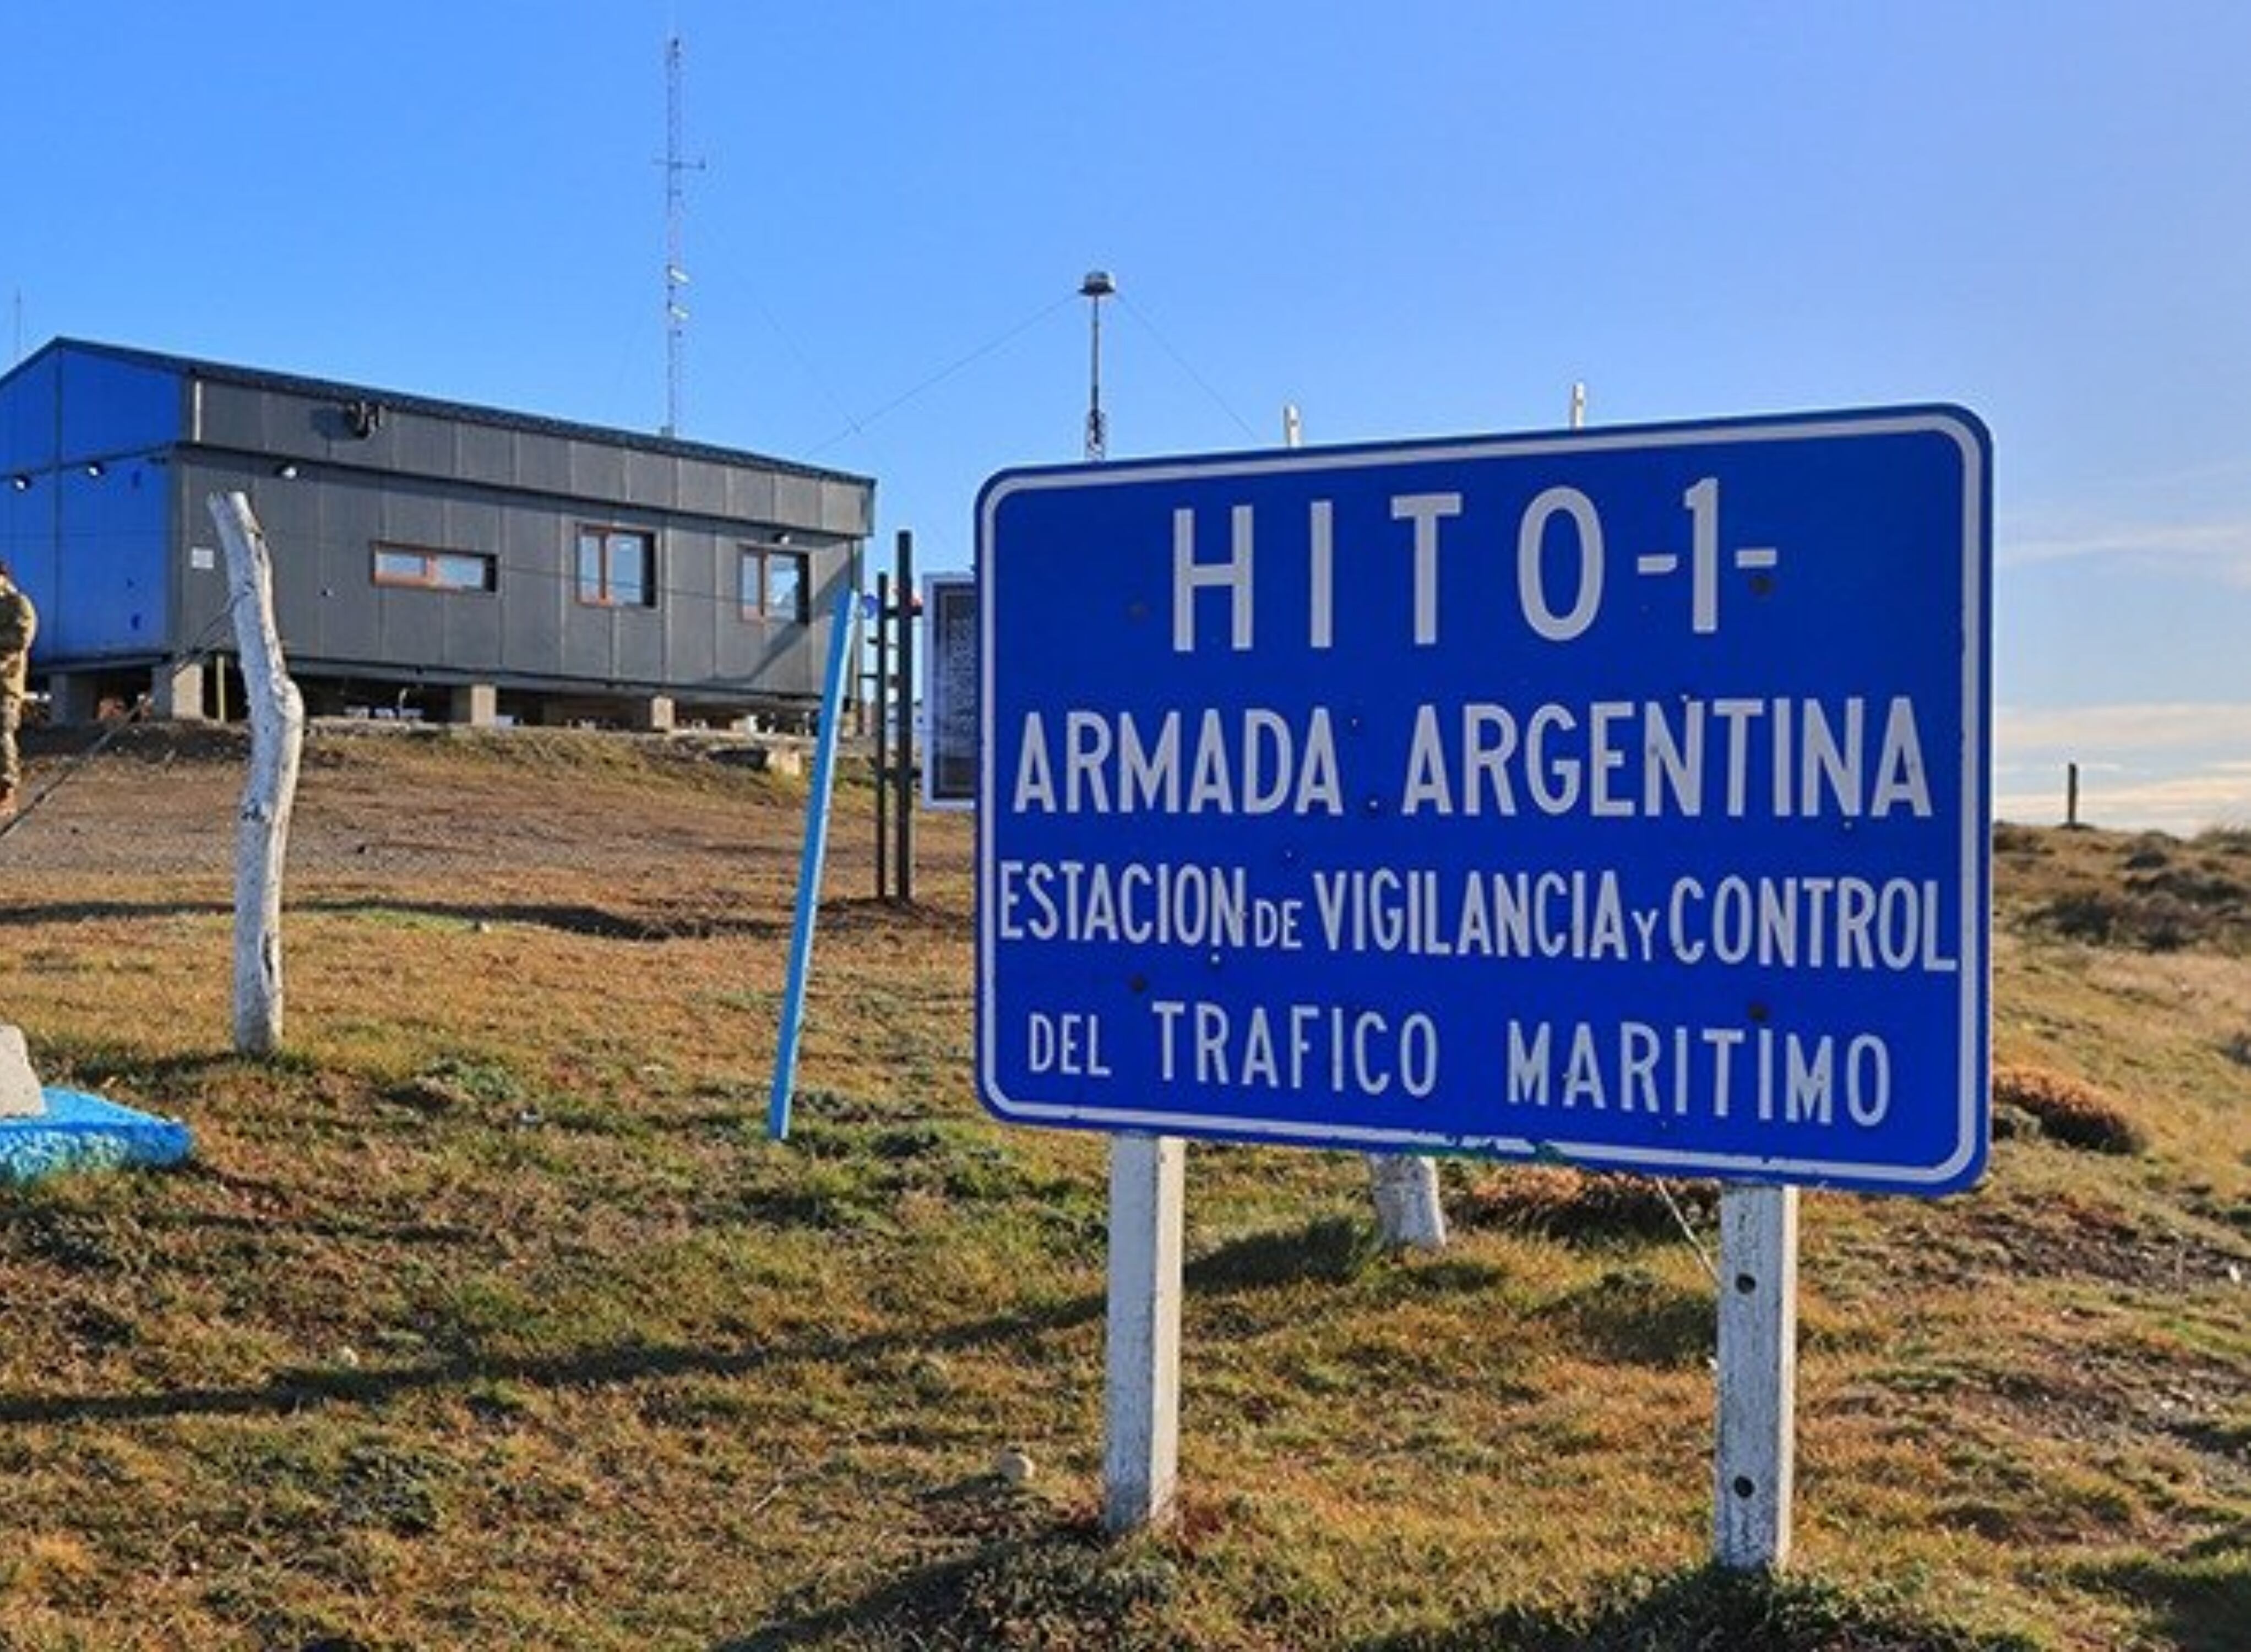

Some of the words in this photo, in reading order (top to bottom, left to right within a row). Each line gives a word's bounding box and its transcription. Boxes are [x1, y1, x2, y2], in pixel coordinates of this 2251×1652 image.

[1175, 487, 1603, 651] HITO
[1015, 708, 1342, 814] ARMADA
[1402, 698, 1931, 816] ARGENTINA
[1001, 862, 1246, 946] ESTACION
[1255, 899, 1302, 948] DE
[1314, 870, 1627, 959] VIGILANCIA
[1633, 910, 1657, 960] Y
[1671, 877, 1956, 970] CONTROL
[1031, 1014, 1110, 1075] DEL
[1153, 1002, 1436, 1095] TRAFICO
[1509, 1021, 1888, 1124] MARITIMO
